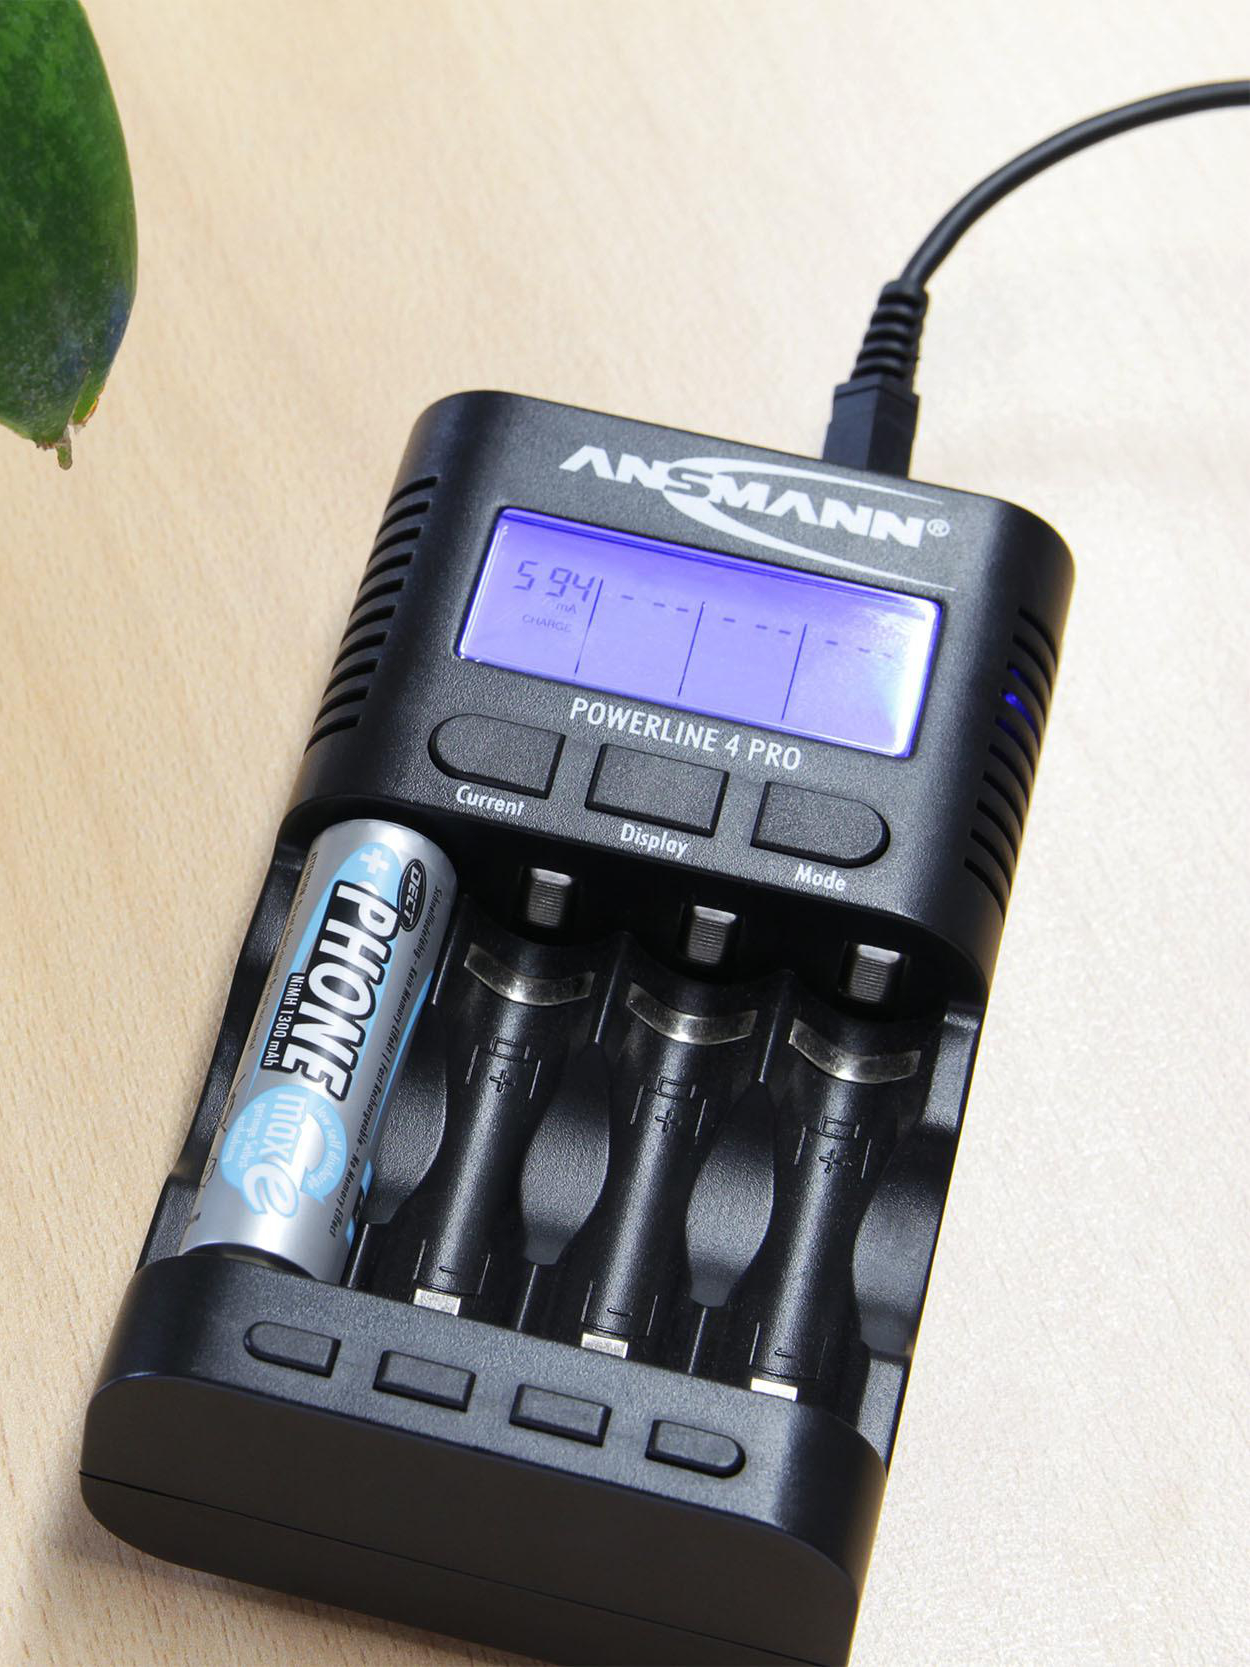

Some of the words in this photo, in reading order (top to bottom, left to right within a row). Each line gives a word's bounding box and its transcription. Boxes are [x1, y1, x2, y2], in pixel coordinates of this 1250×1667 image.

[521, 614, 572, 633] CHARGE
[569, 697, 719, 754] POWERLINE
[724, 734, 740, 758] 4
[748, 741, 802, 771] PRO
[455, 784, 525, 817] Current
[620, 822, 689, 859] Display
[795, 863, 847, 892] Mode
[402, 866, 422, 925] DECT
[280, 884, 399, 1097] PHONE
[283, 974, 306, 1006] NiMH
[393, 986, 411, 1025] Memory
[272, 1008, 294, 1039] 1300
[262, 1041, 280, 1067] mAh
[357, 1082, 382, 1146] Rechargeable
[350, 1153, 360, 1168] No
[336, 1167, 356, 1208] Memory
[329, 1208, 344, 1239] Effect
